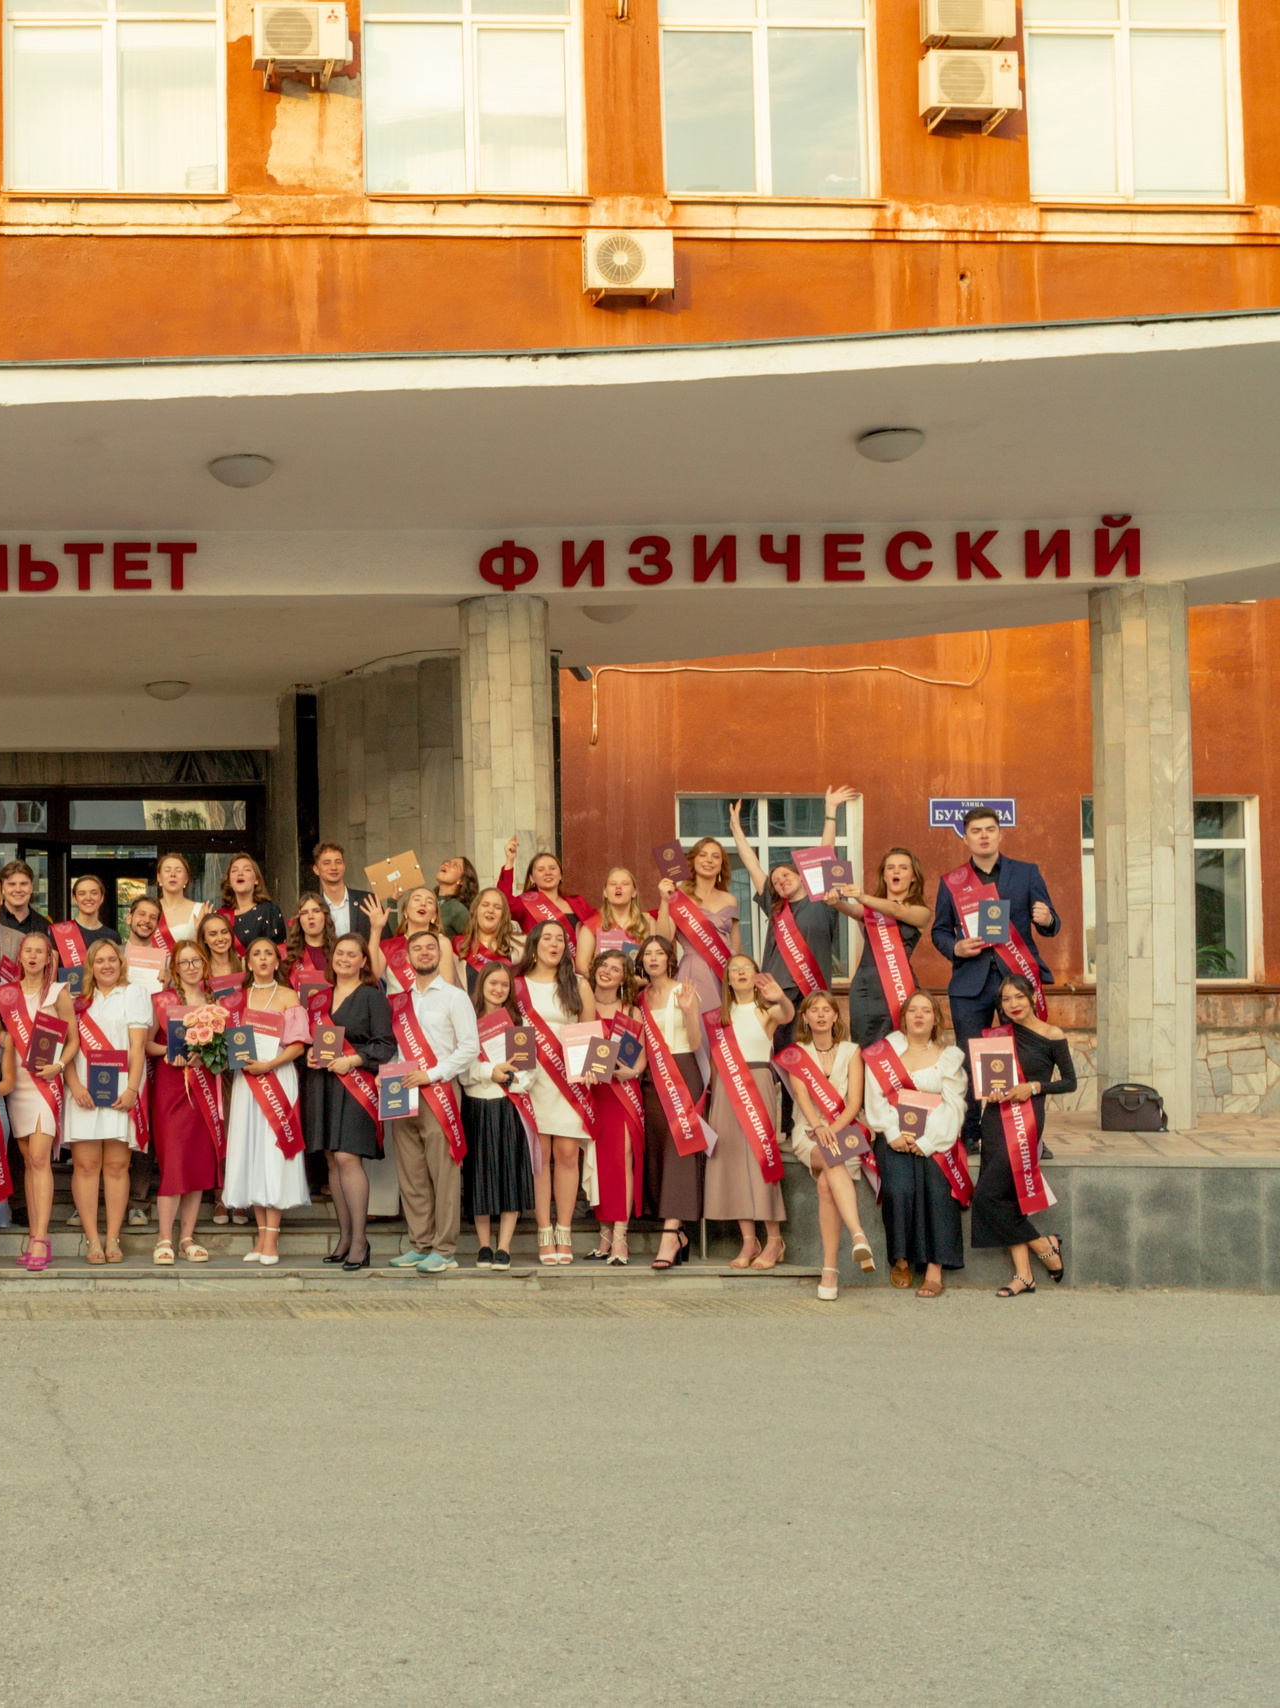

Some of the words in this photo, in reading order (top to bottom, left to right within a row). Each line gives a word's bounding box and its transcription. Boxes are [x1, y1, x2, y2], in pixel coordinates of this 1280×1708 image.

[478, 514, 1142, 592] ФИЗИЧЕСКИЙ
[934, 809, 1012, 821] БУКВА
[677, 905, 713, 947] ЛУЧШИЙ
[776, 919, 804, 965] ЛУЧШИЙ
[399, 1012, 421, 1060] ЛУЧШИЙ
[654, 1050, 686, 1118] ВЫПУСКНИК
[678, 1116, 694, 1140] 2024
[715, 1028, 740, 1075] ЛУЧШИЙ
[732, 1072, 769, 1143] ВЫПУСКНИК
[762, 1142, 776, 1168] 2024
[800, 1067, 838, 1113] ЛУЧШИЙ
[281, 1117, 295, 1143] 2024
[451, 1122, 462, 1147] 2024
[582, 1103, 596, 1125] 2024
[950, 1167, 966, 1190] 2024
[1024, 1172, 1037, 1198] 2024
